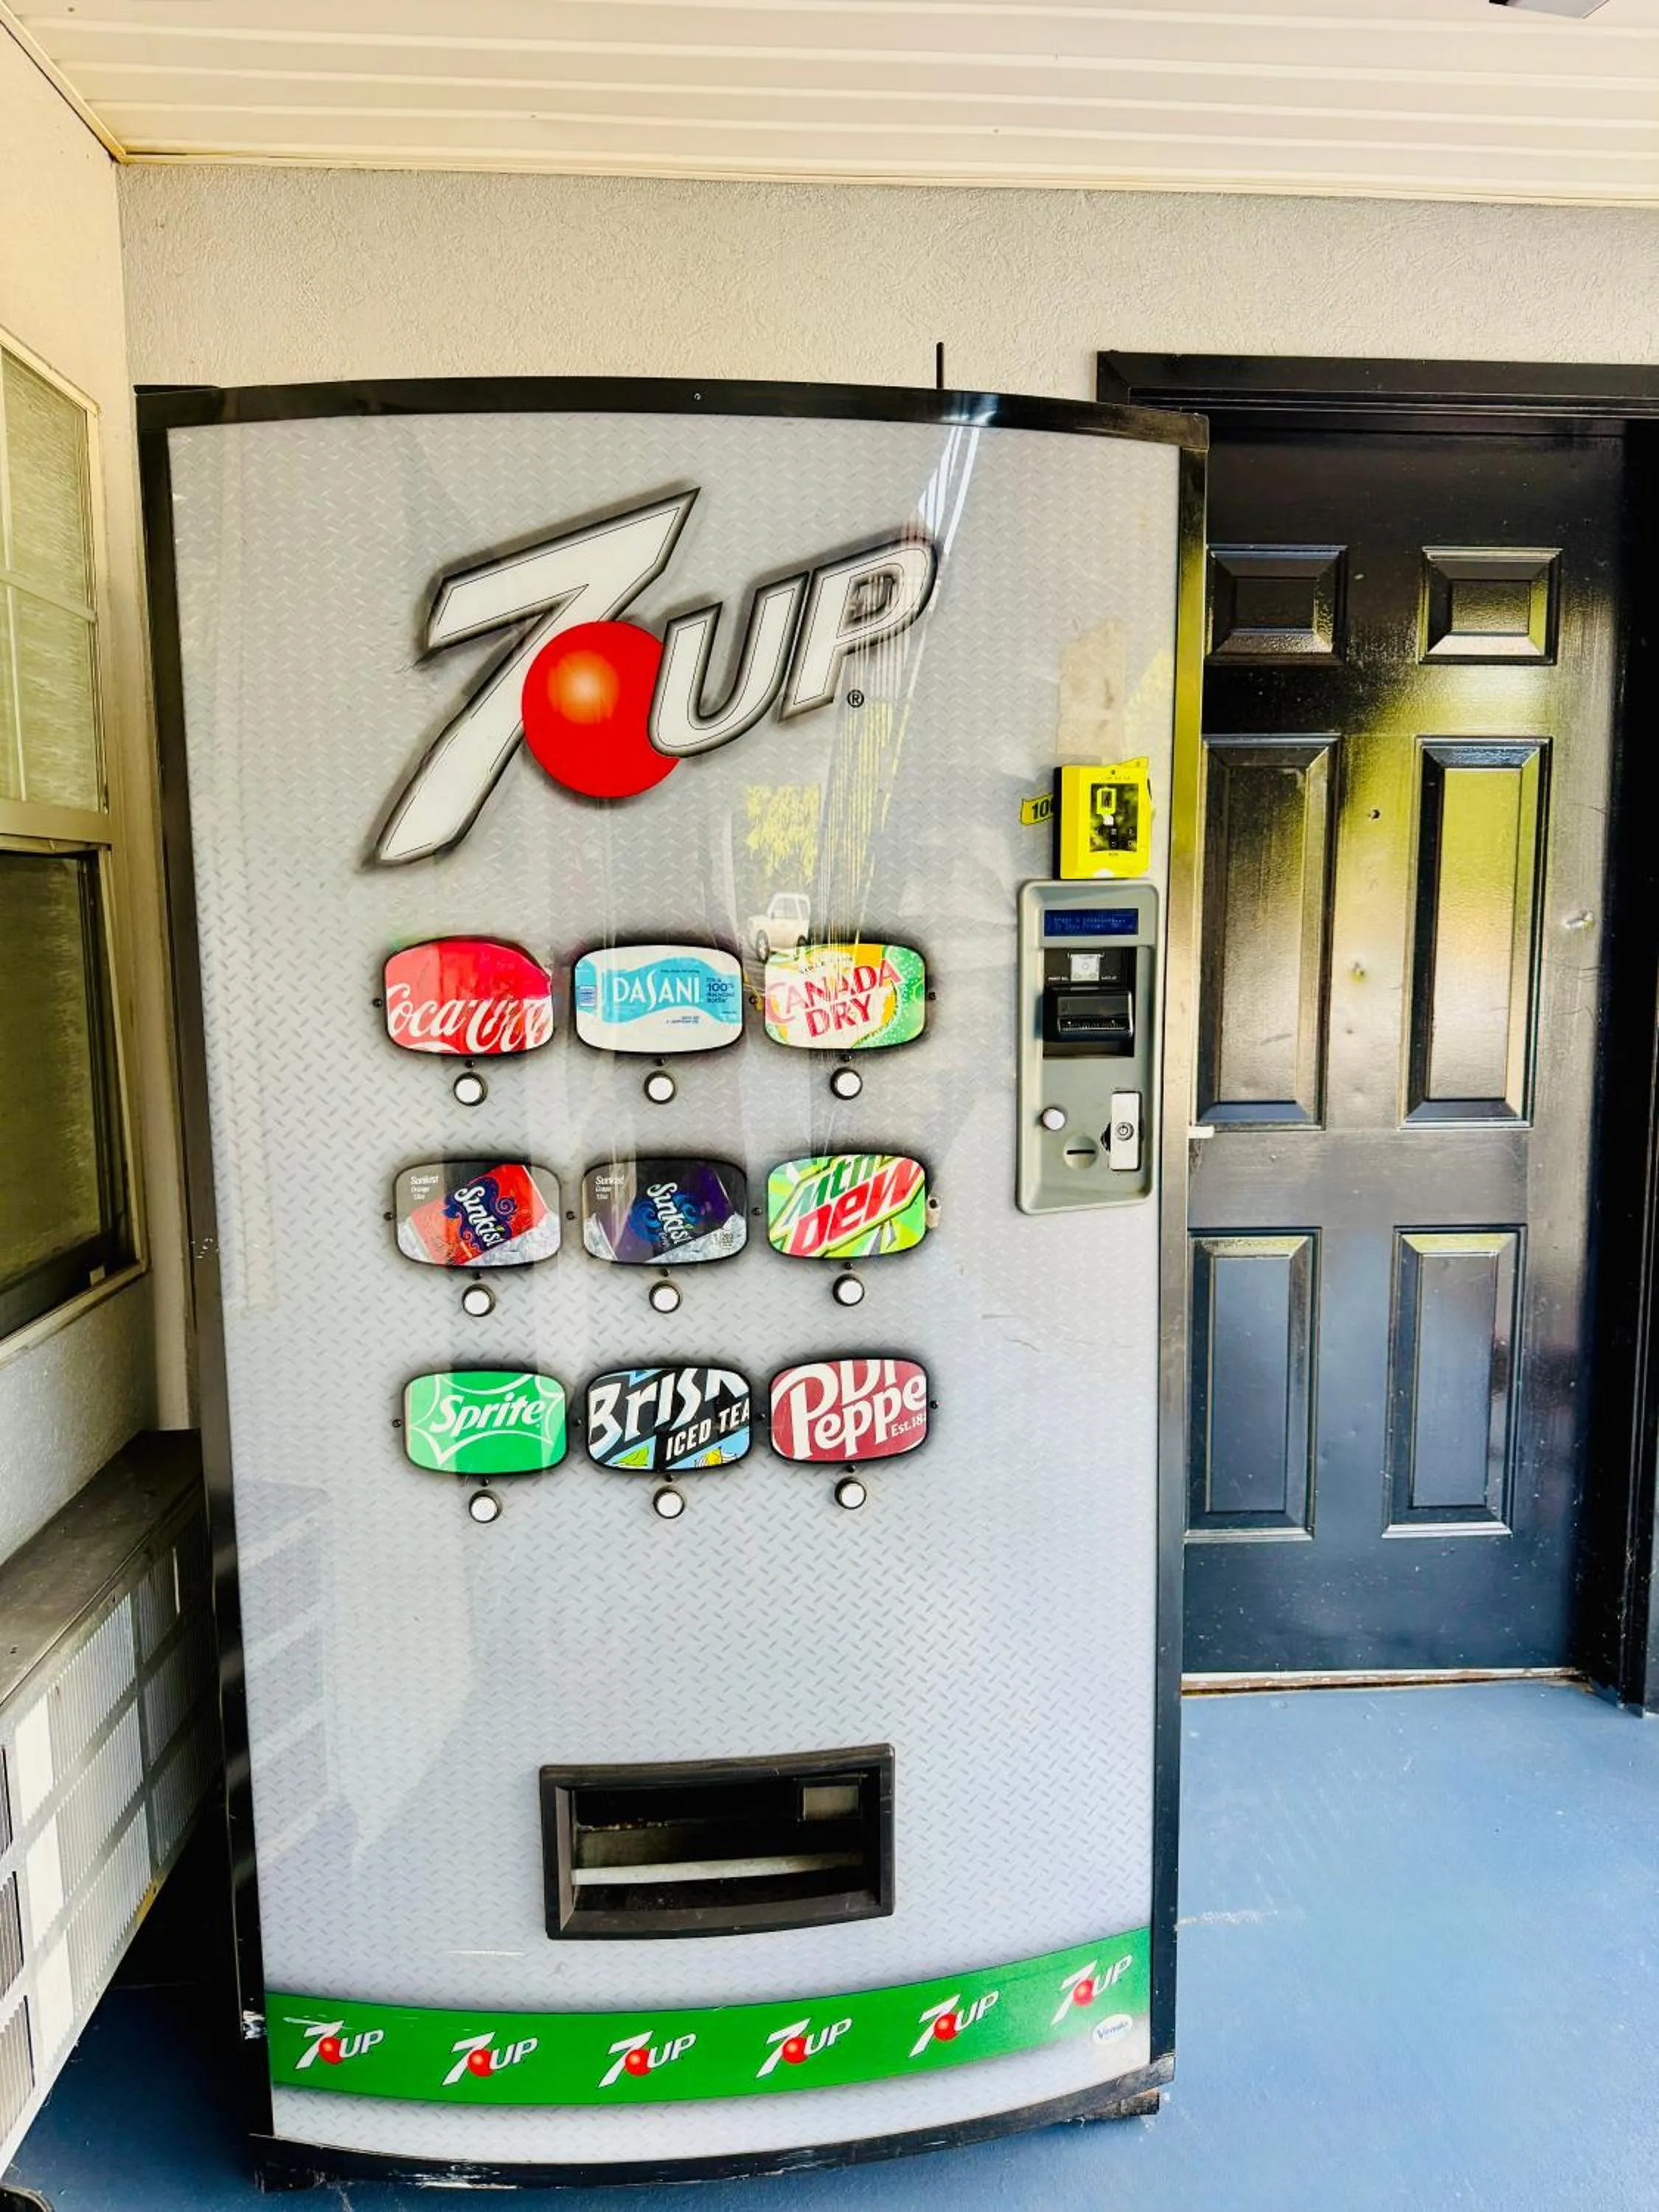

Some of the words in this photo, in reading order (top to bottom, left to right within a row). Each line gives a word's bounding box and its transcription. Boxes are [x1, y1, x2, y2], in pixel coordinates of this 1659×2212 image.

[613, 969, 700, 1011] DASANI
[765, 959, 902, 1023] CANADA
[805, 994, 872, 1037] DRY
[428, 1391, 545, 1437] Sprite
[666, 1417, 712, 1461] ICED
